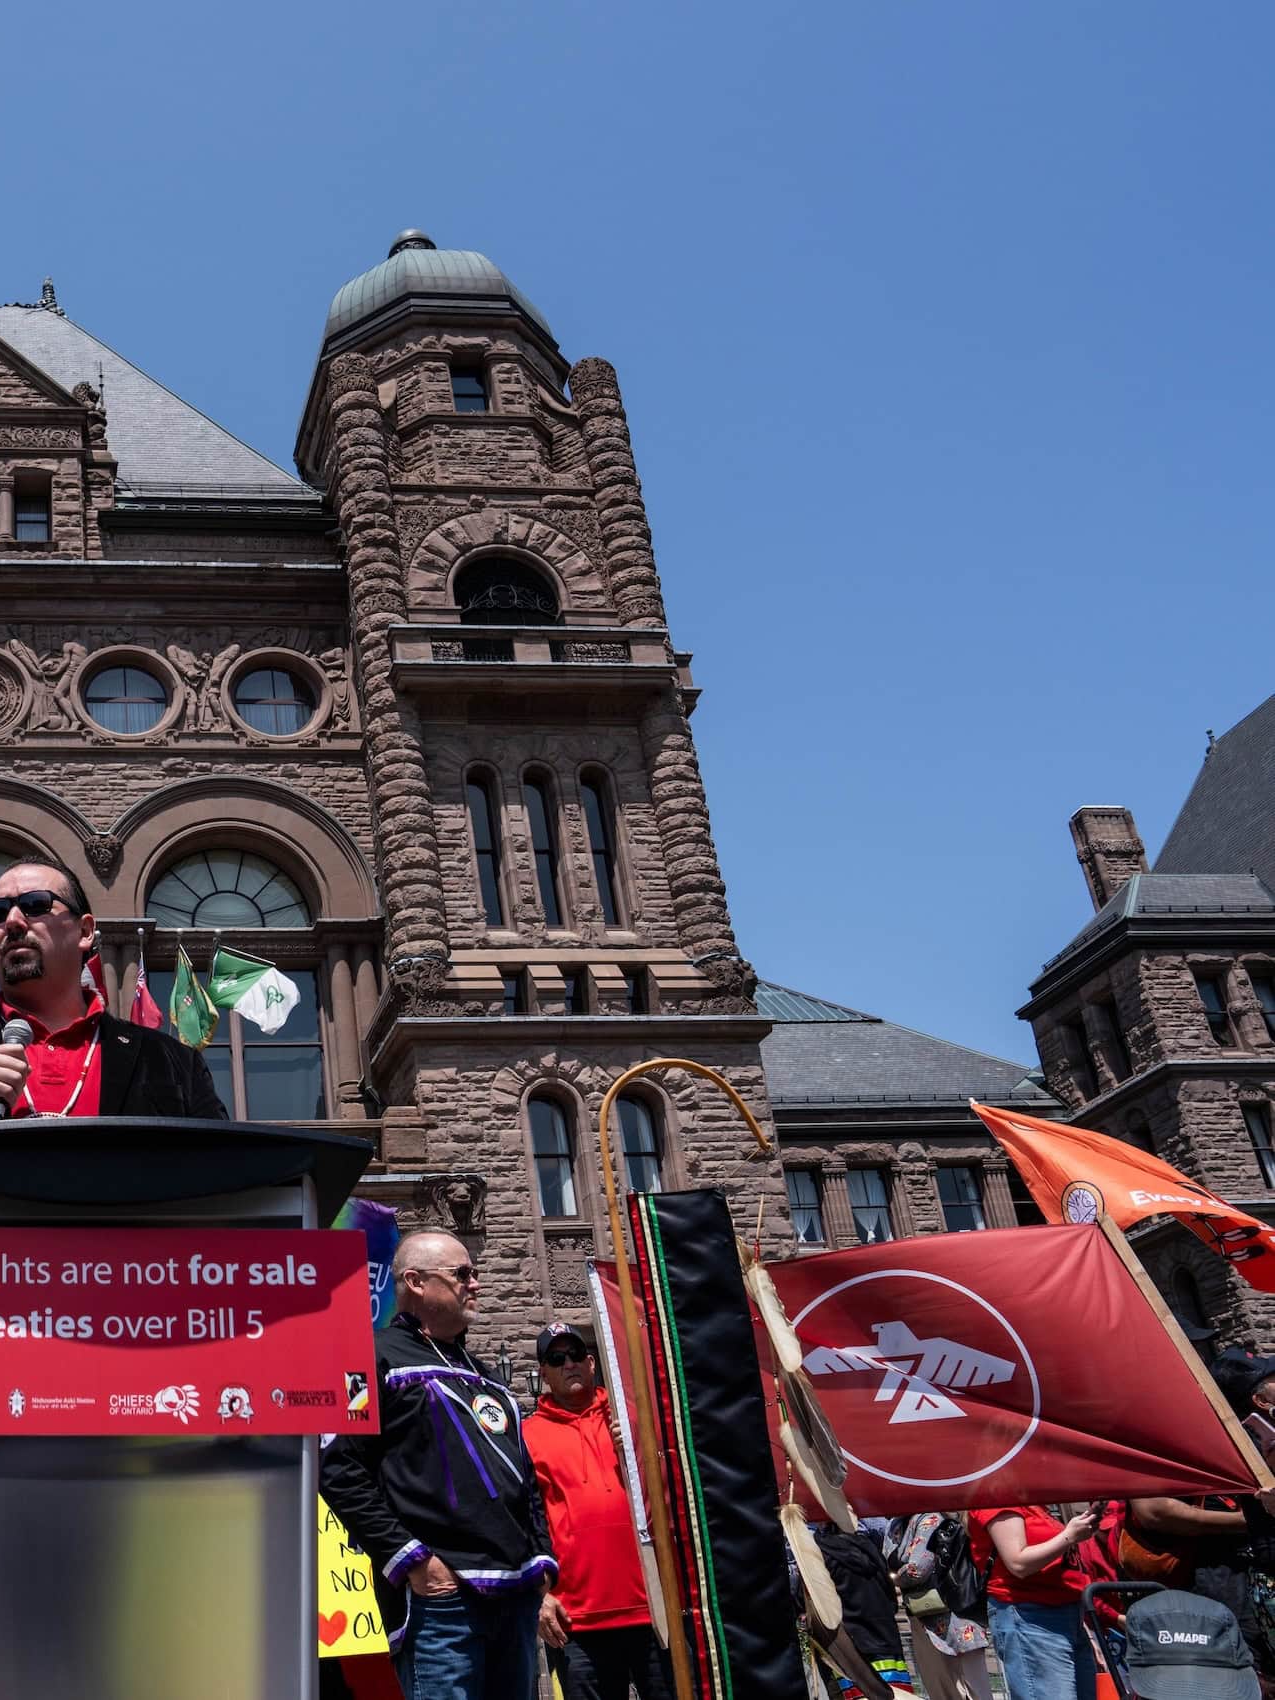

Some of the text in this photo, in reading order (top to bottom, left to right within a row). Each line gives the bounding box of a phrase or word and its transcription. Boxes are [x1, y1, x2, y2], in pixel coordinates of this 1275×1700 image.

[60, 1262, 112, 1285] are
[123, 1258, 179, 1285] not
[187, 1254, 238, 1285] for
[248, 1254, 317, 1285] sale
[103, 1316, 177, 1339] over
[187, 1307, 235, 1339] Bill
[246, 1310, 264, 1340] 5
[109, 1394, 154, 1408] CHIEFS
[109, 1407, 155, 1417] OF ONTARIO
[331, 1566, 367, 1593] NO
[1174, 1632, 1208, 1646] MAPEI
